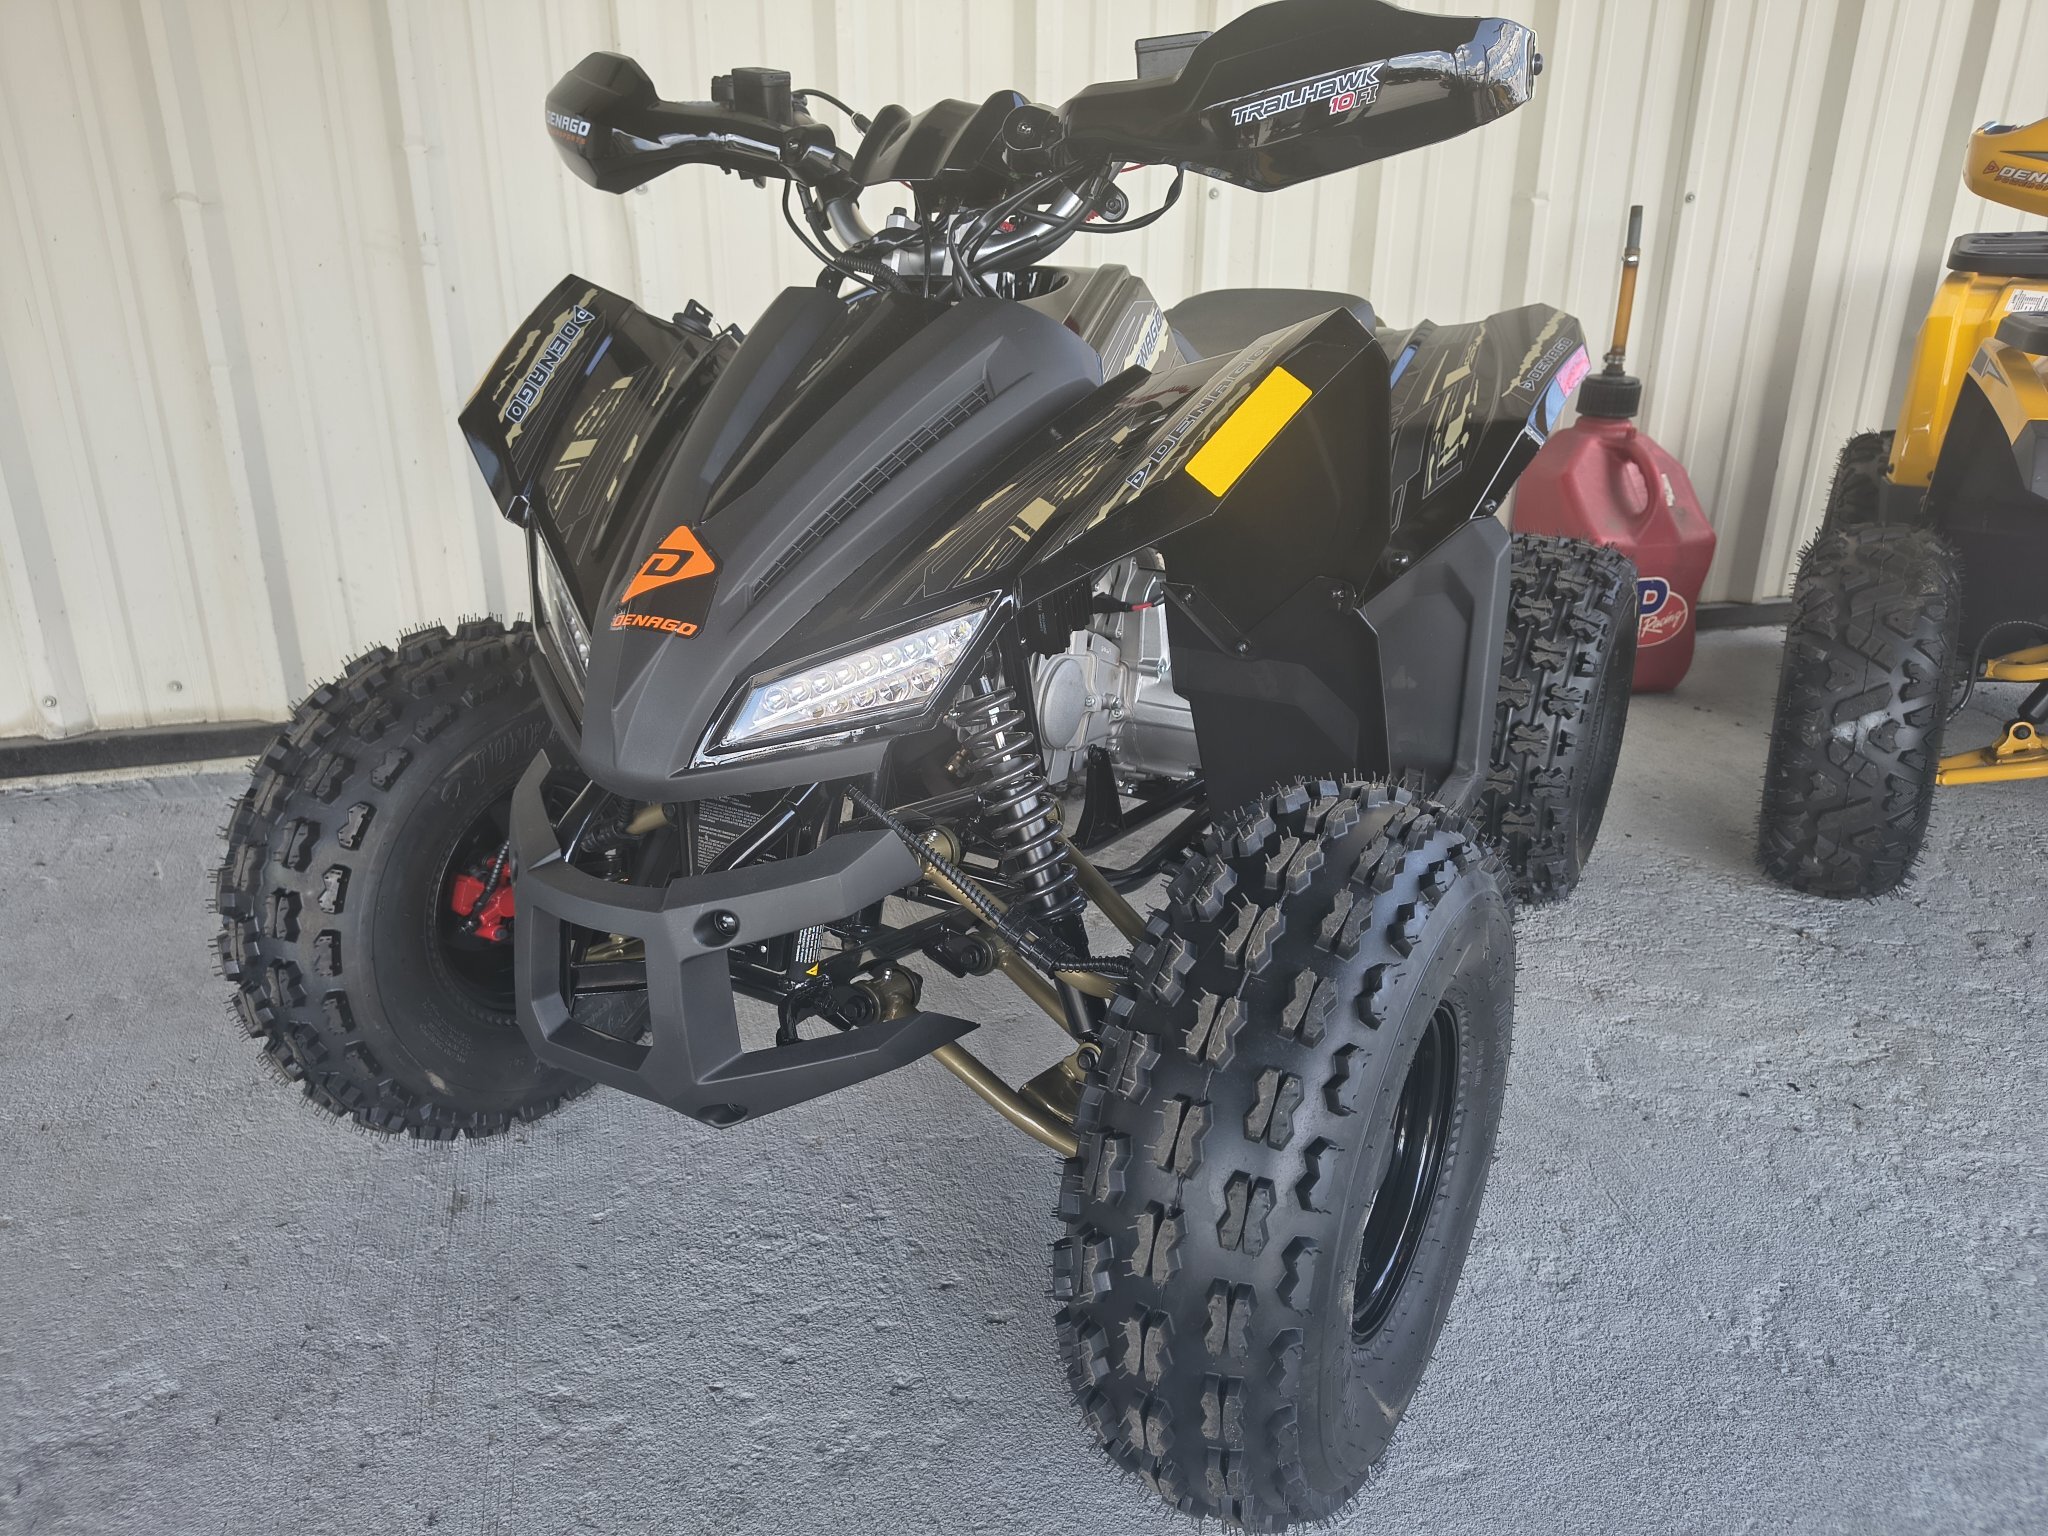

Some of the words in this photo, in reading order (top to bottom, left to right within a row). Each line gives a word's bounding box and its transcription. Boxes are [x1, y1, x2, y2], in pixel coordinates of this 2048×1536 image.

[1998, 165, 2048, 185] DEN
[505, 320, 581, 424] DENAGO
[1149, 344, 1275, 463] DENAGO
[611, 613, 698, 637] DENAGO
[1641, 609, 1686, 639] Racing
